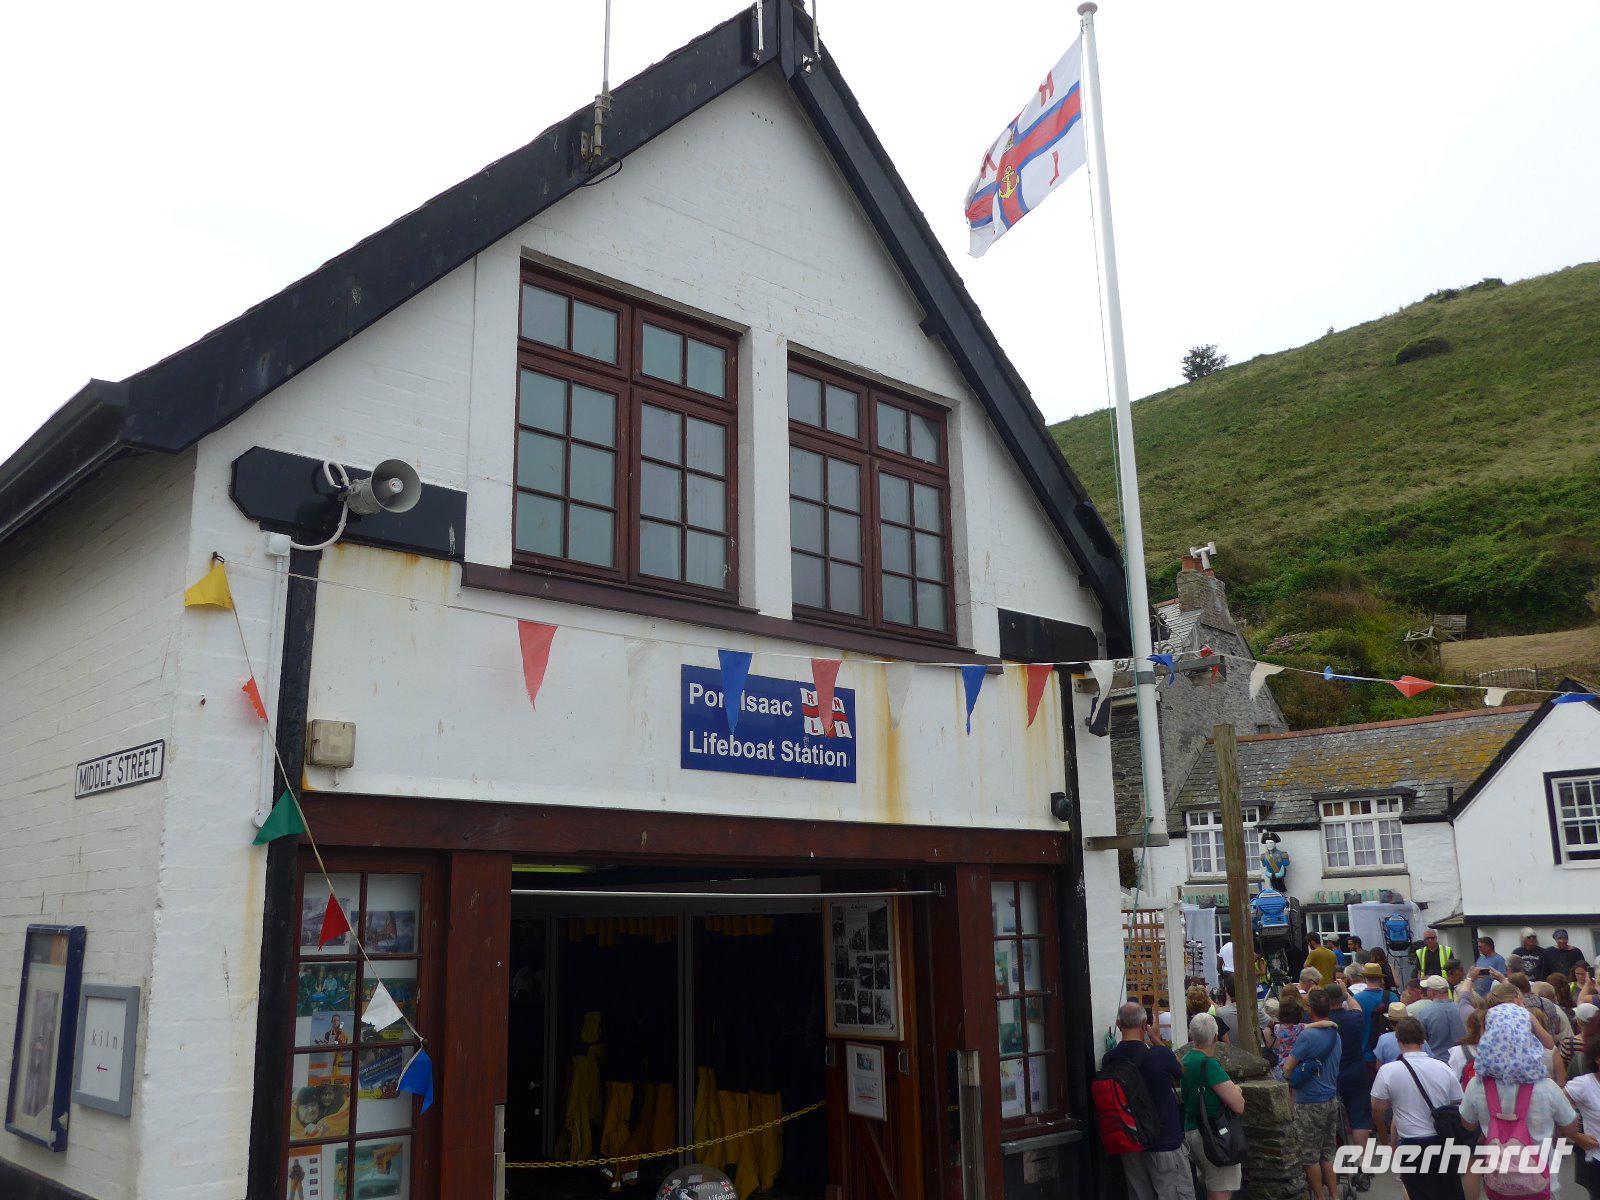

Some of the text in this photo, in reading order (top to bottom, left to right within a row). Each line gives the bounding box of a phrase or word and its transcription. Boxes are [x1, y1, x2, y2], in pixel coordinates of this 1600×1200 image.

[689, 682, 793, 717] Por Isaac
[689, 730, 848, 768] Lifeboat Station
[79, 747, 158, 793] MIDDLE STREET
